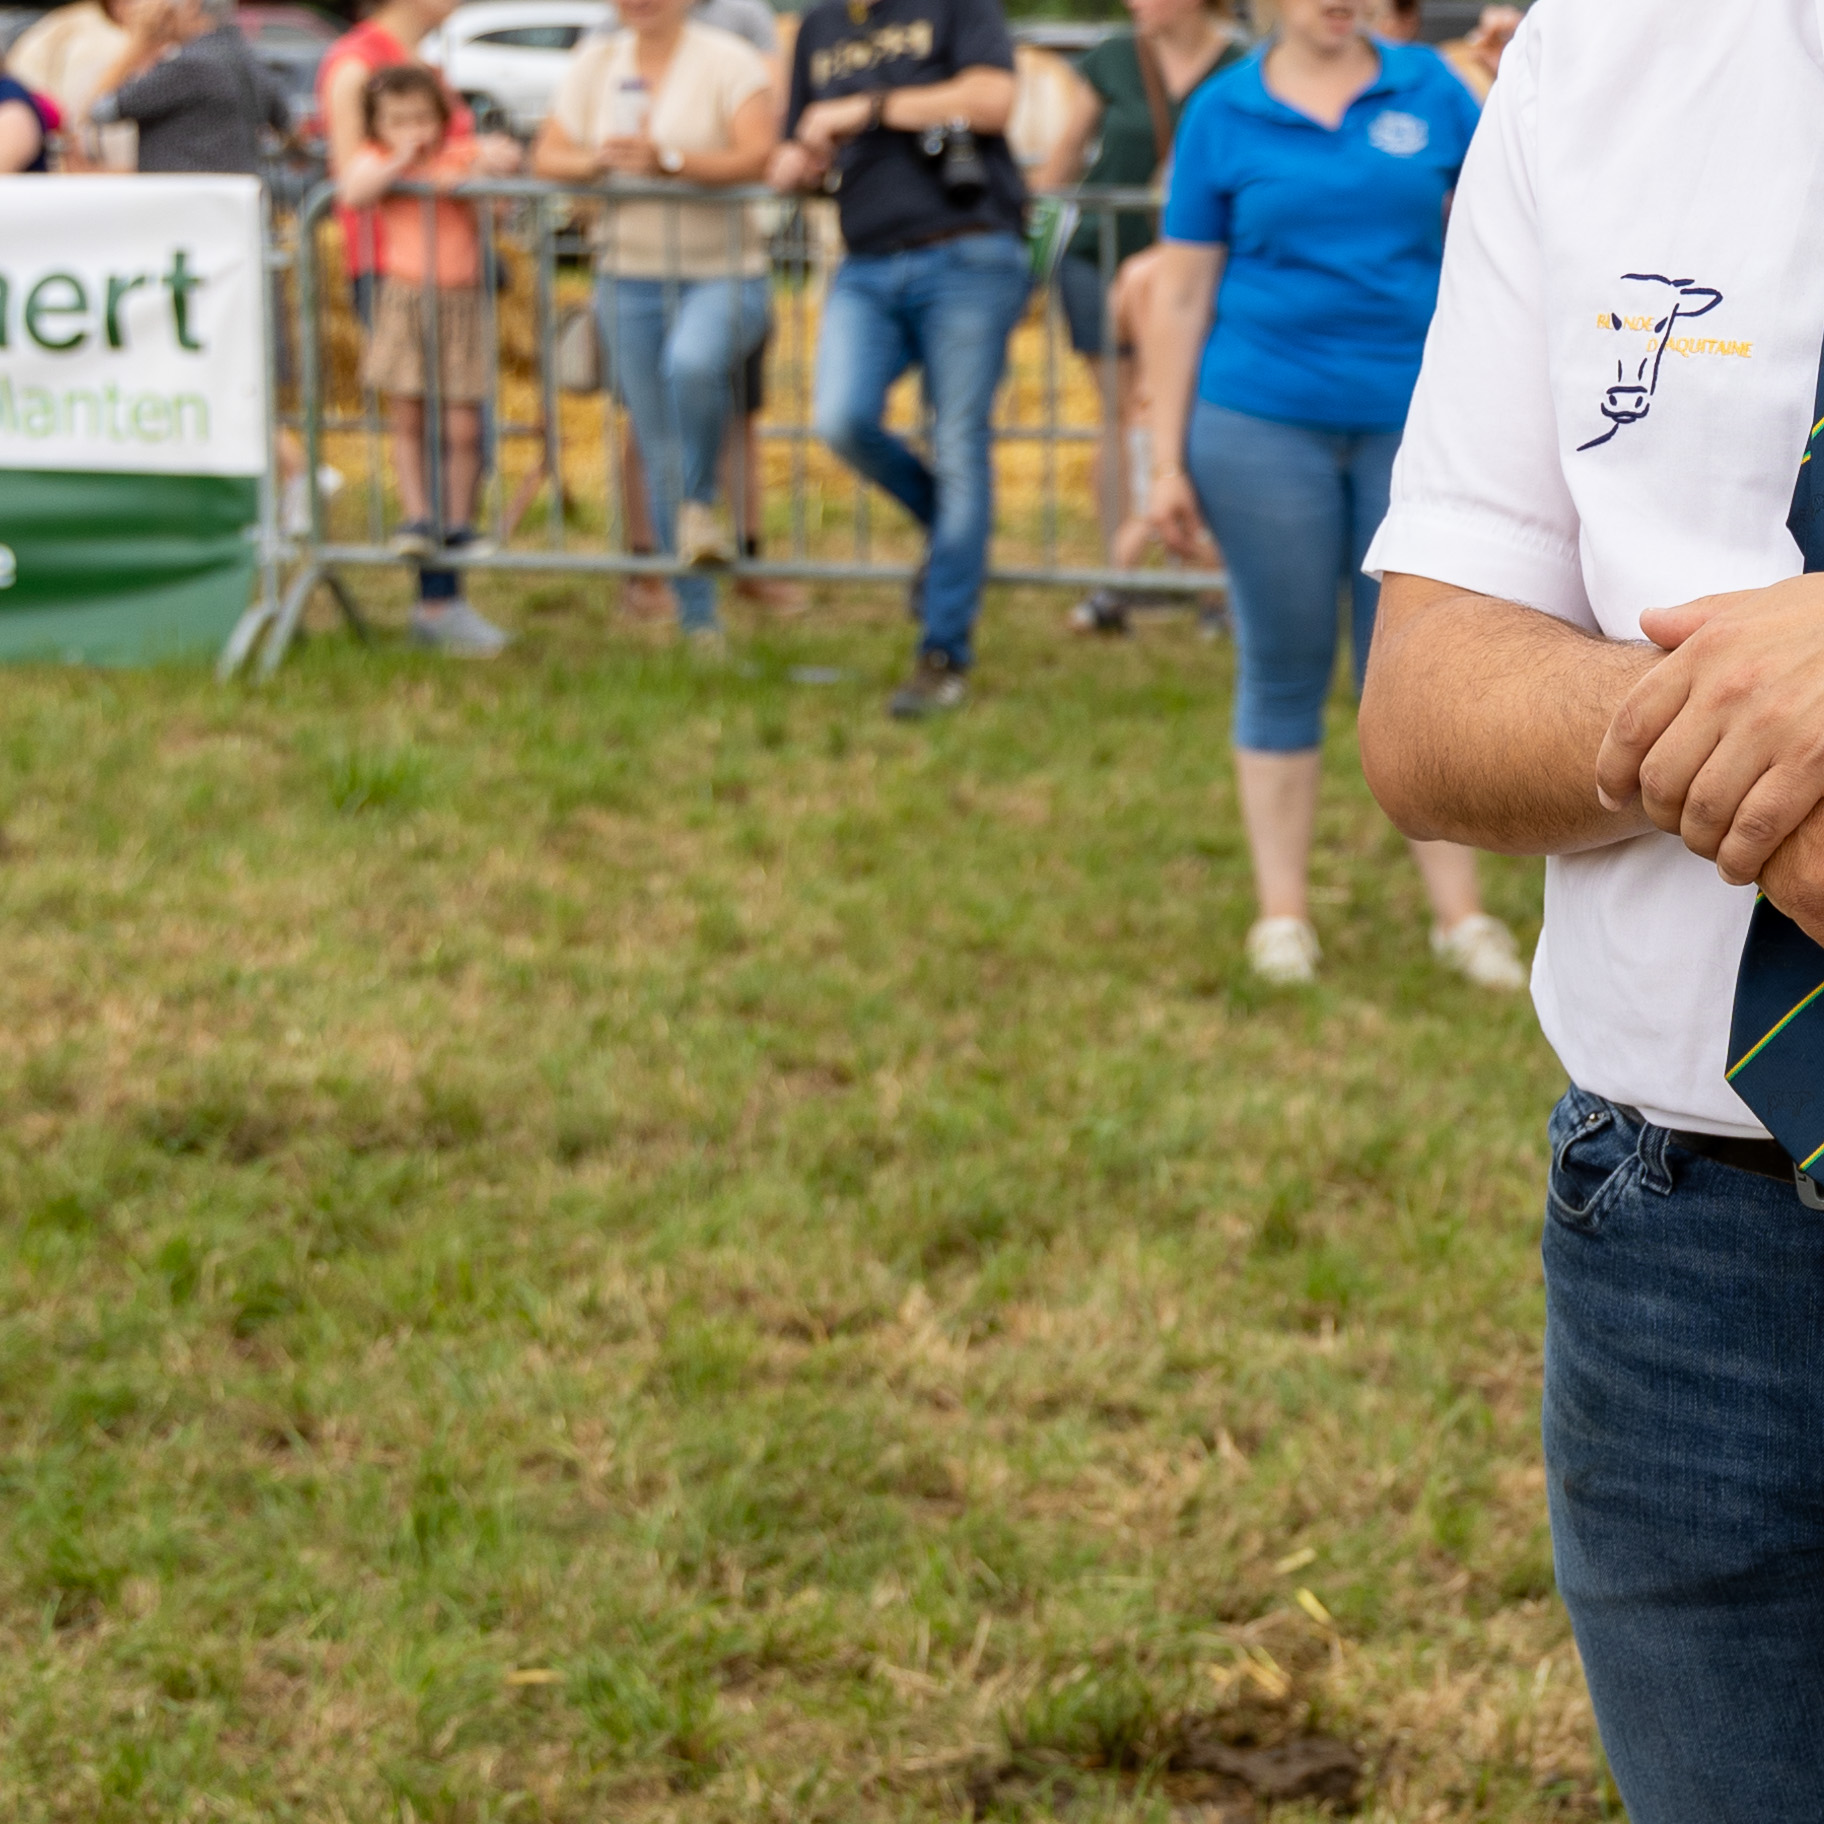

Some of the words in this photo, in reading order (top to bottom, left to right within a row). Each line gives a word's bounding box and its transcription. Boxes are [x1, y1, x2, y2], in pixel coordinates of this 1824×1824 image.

[0, 247, 204, 352] ert
[1597, 314, 1654, 332] BLNDE
[1647, 336, 1753, 358] DAQUITAINE
